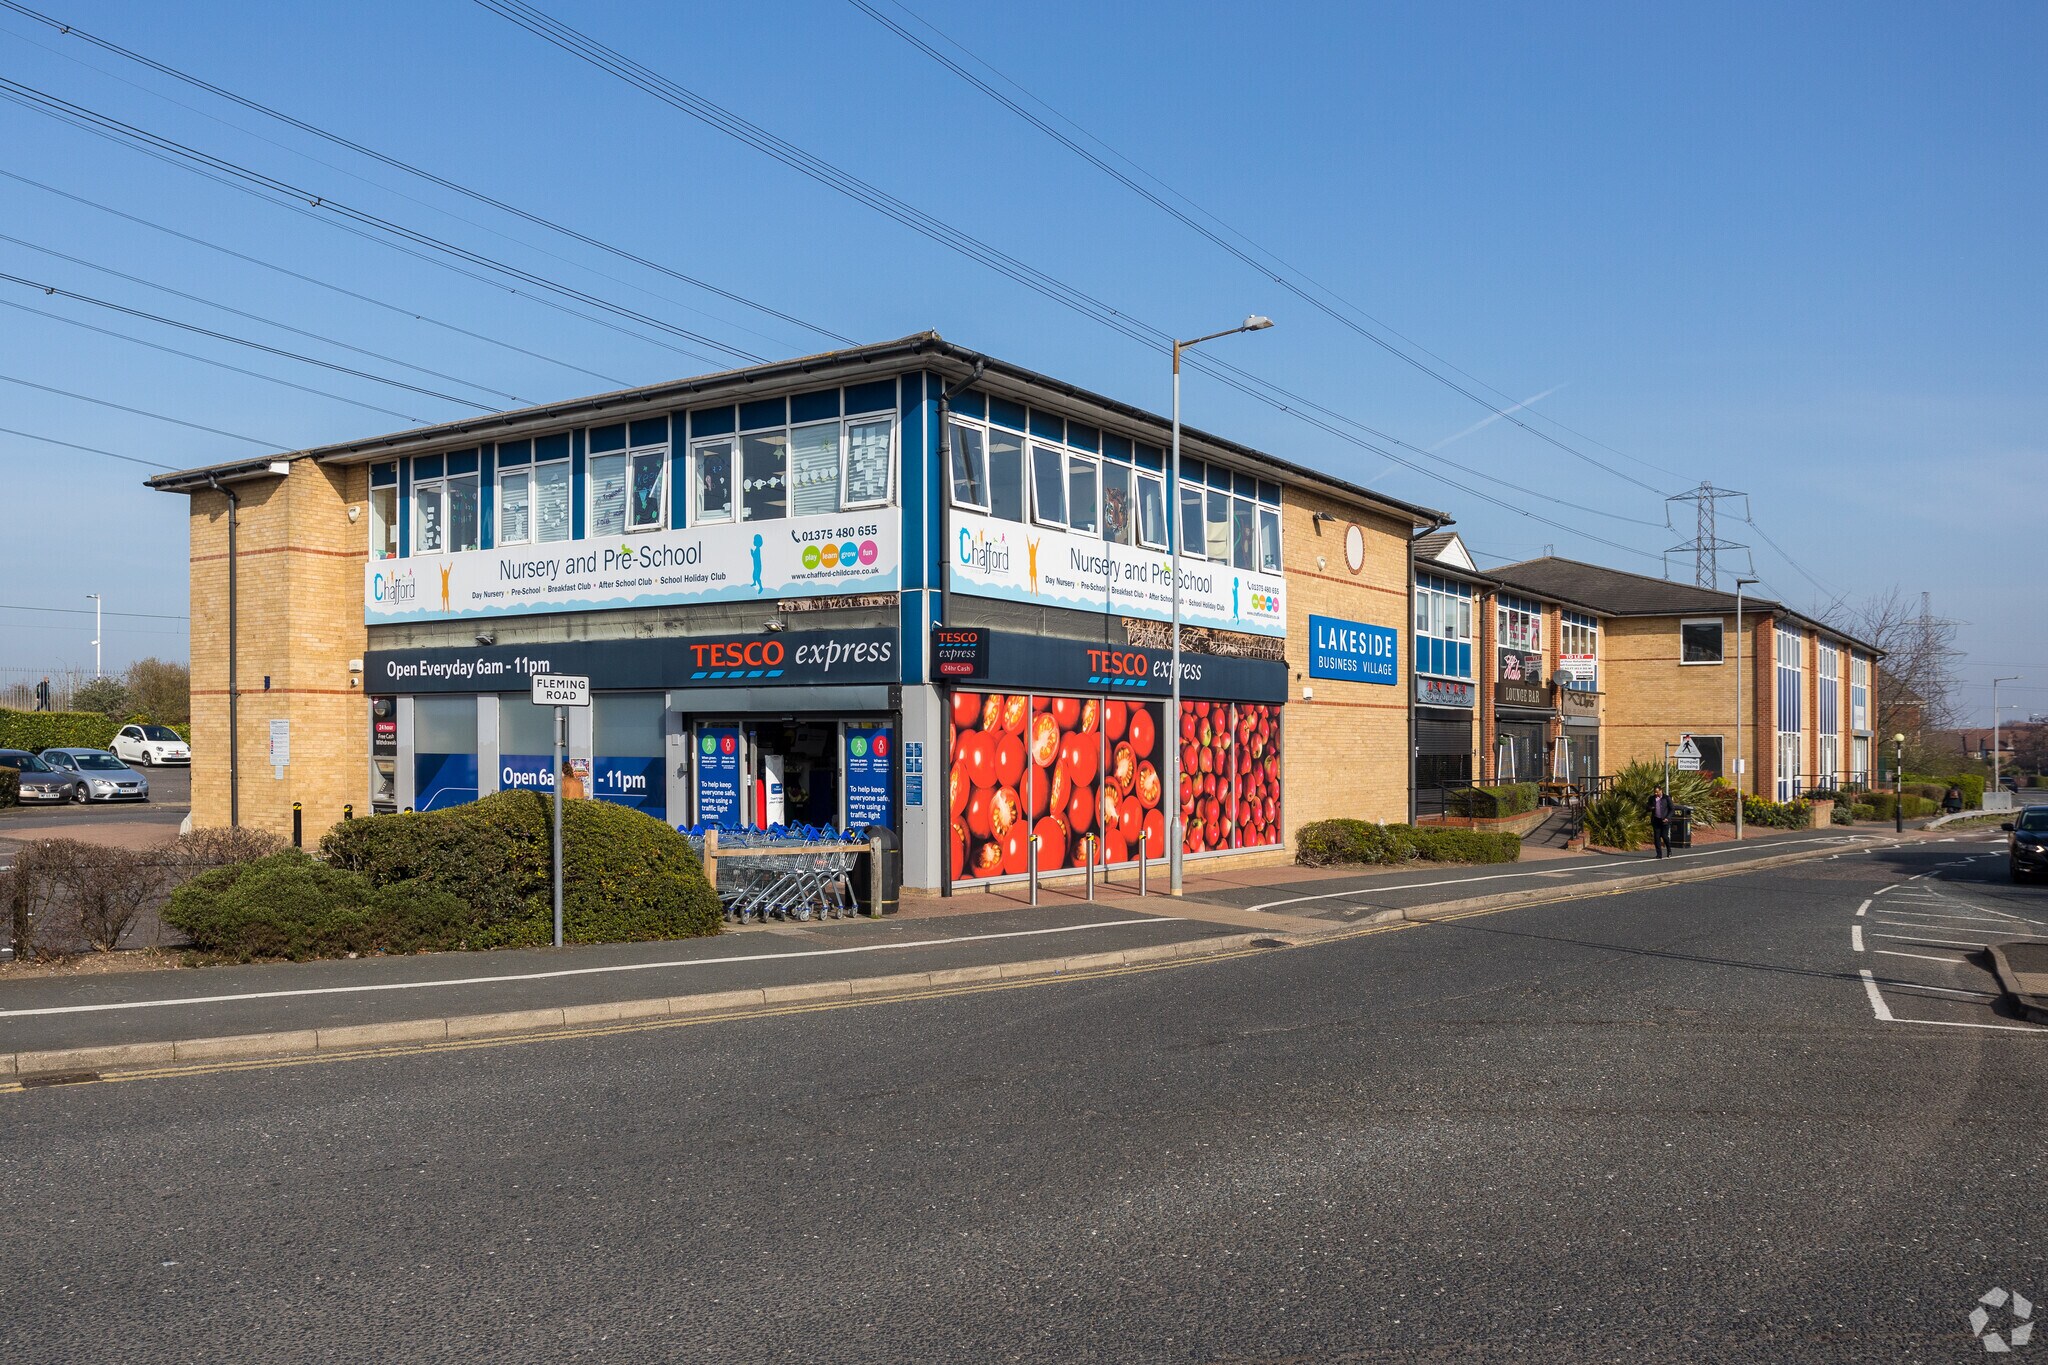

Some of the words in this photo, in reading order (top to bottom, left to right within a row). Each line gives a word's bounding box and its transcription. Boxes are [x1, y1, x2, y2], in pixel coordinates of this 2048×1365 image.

[802, 529, 833, 541] 01375
[836, 527, 855, 538] 480
[858, 525, 877, 536] 655
[805, 554, 817, 562] play
[822, 552, 837, 560] learn
[841, 551, 856, 559] grow
[863, 548, 873, 556] fun
[959, 527, 1008, 574] Chafford
[500, 559, 559, 581] Nursery
[566, 551, 596, 574] and
[604, 541, 701, 571] Pre-School
[1070, 548, 1120, 582] Nursery
[1124, 562, 1147, 582] and
[791, 567, 879, 580] www.chafford-childcare.co.uk
[374, 573, 415, 605] Chafford
[472, 591, 482, 600] Day
[484, 590, 504, 598] Nursery
[511, 587, 541, 595] Pre-School
[548, 583, 576, 593] Breakfast
[577, 582, 591, 590] Club
[616, 579, 636, 587] School
[638, 577, 652, 586] Club
[660, 575, 682, 584] School
[684, 573, 708, 583] Holiday
[710, 572, 726, 580] Club
[1045, 575, 1055, 585] Day
[1056, 577, 1075, 589] Nursery
[1081, 581, 1106, 592] Pre-School
[1111, 586, 1133, 597] Breakfast
[1133, 590, 1144, 598] Club
[1149, 592, 1159, 600] After
[1160, 594, 1173, 603] Schoo
[1188, 599, 1202, 607] School
[1203, 601, 1216, 611] Holiday
[938, 632, 978, 643] TESCO
[1318, 625, 1392, 658] LAKESIDE
[690, 640, 784, 667] TESCO
[795, 640, 891, 671] express
[939, 649, 976, 660] express
[387, 660, 417, 680] Open
[420, 658, 474, 679] Everyday
[476, 658, 503, 675] 6am
[514, 657, 550, 676] 11pm
[1087, 649, 1148, 677] TESCO
[1318, 655, 1357, 672] BUSINESS
[1362, 661, 1392, 676] VILLAGE
[537, 678, 585, 689] FLEMING
[546, 691, 577, 700] ROAD
[1505, 687, 1527, 702] LOUNGE
[1528, 690, 1540, 703] BAR
[503, 767, 536, 788] Open
[539, 768, 554, 786] 6a
[606, 770, 646, 792] 11pm
[708, 781, 719, 789] help
[720, 781, 732, 789] keep
[725, 789, 736, 797] safe,
[858, 786, 870, 794] help
[871, 786, 885, 794] keep
[716, 797, 728, 805] using
[850, 795, 876, 803] everyone
[877, 794, 890, 802] safe,
[717, 804, 728, 813] light
[866, 803, 881, 811] using
[868, 811, 880, 820] light
[850, 820, 870, 828] system
